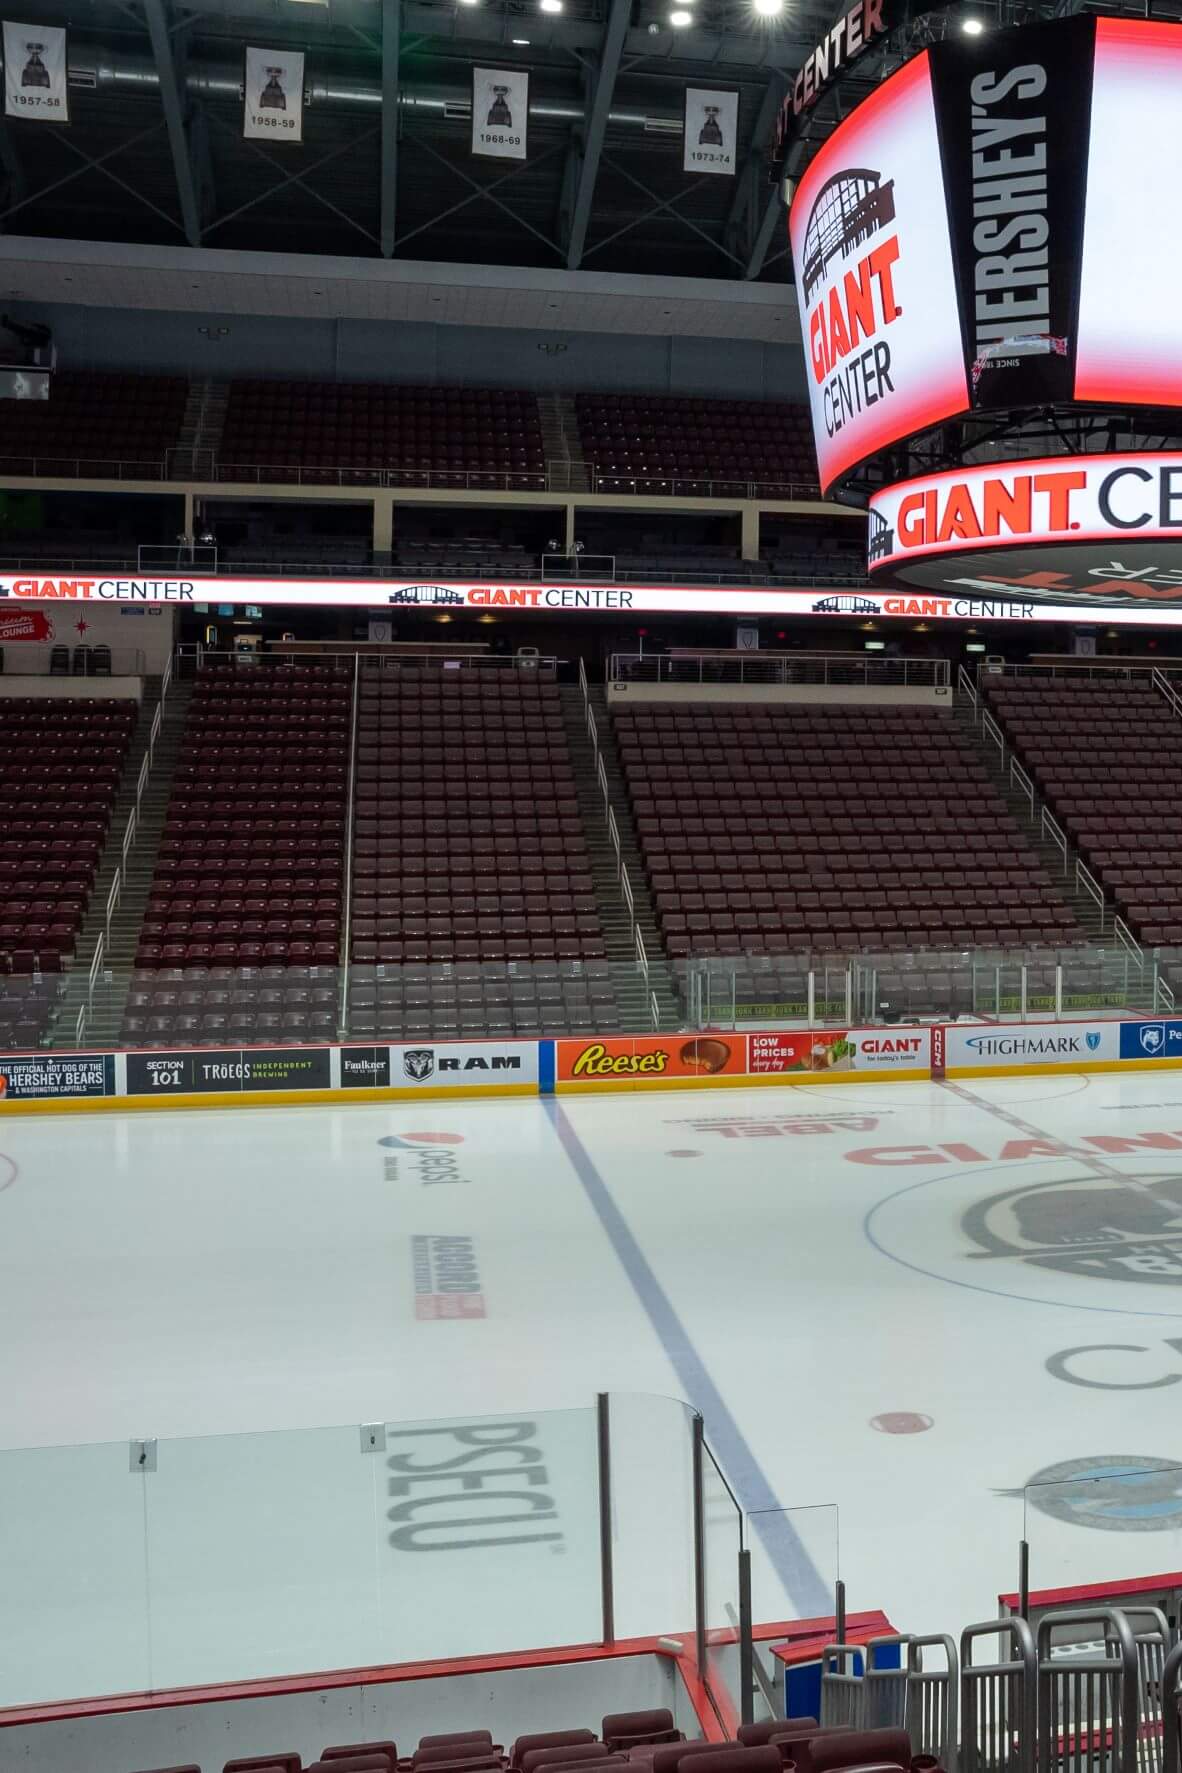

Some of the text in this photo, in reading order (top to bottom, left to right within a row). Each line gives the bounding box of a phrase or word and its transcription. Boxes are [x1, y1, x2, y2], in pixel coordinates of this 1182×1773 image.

[793, 0, 888, 115] CENTER
[12, 95, 61, 107] 1957-58
[251, 116, 296, 130] 1958-59
[480, 133, 521, 147] 1968-69
[692, 151, 731, 165] 1973-74
[970, 63, 1050, 357] HERSHEY'S
[808, 234, 901, 385] GIANT
[822, 340, 895, 438] CENTER
[896, 470, 1086, 548] GIANT
[13, 580, 194, 600] GIANT CENTER
[467, 588, 633, 608] GIANT CENTER
[883, 598, 1034, 618] GIANT CENTER
[0, 624, 35, 639] OUNGE
[753, 1037, 779, 1047] LOW
[860, 1038, 922, 1053] GIANT
[934, 1029, 943, 1067] CCM
[977, 1036, 1081, 1056] HIGHMARK
[573, 1043, 669, 1075] Reese's
[753, 1047, 795, 1058] PRICES
[13, 1064, 45, 1074] OFFICIAL
[46, 1063, 61, 1073] HOT
[62, 1063, 77, 1072] DOG
[79, 1062, 89, 1071] OF
[89, 1062, 103, 1071] THE
[146, 1060, 184, 1071] SECTION
[252, 1060, 313, 1071] INDEPENDENT
[344, 1060, 387, 1070] Faulkner
[438, 1056, 521, 1071] RAM
[9, 1071, 103, 1087] HERSHEY BEARS
[151, 1070, 182, 1086] 101
[405, 1149, 473, 1185] pepsi
[386, 1421, 564, 1552] PSECU
